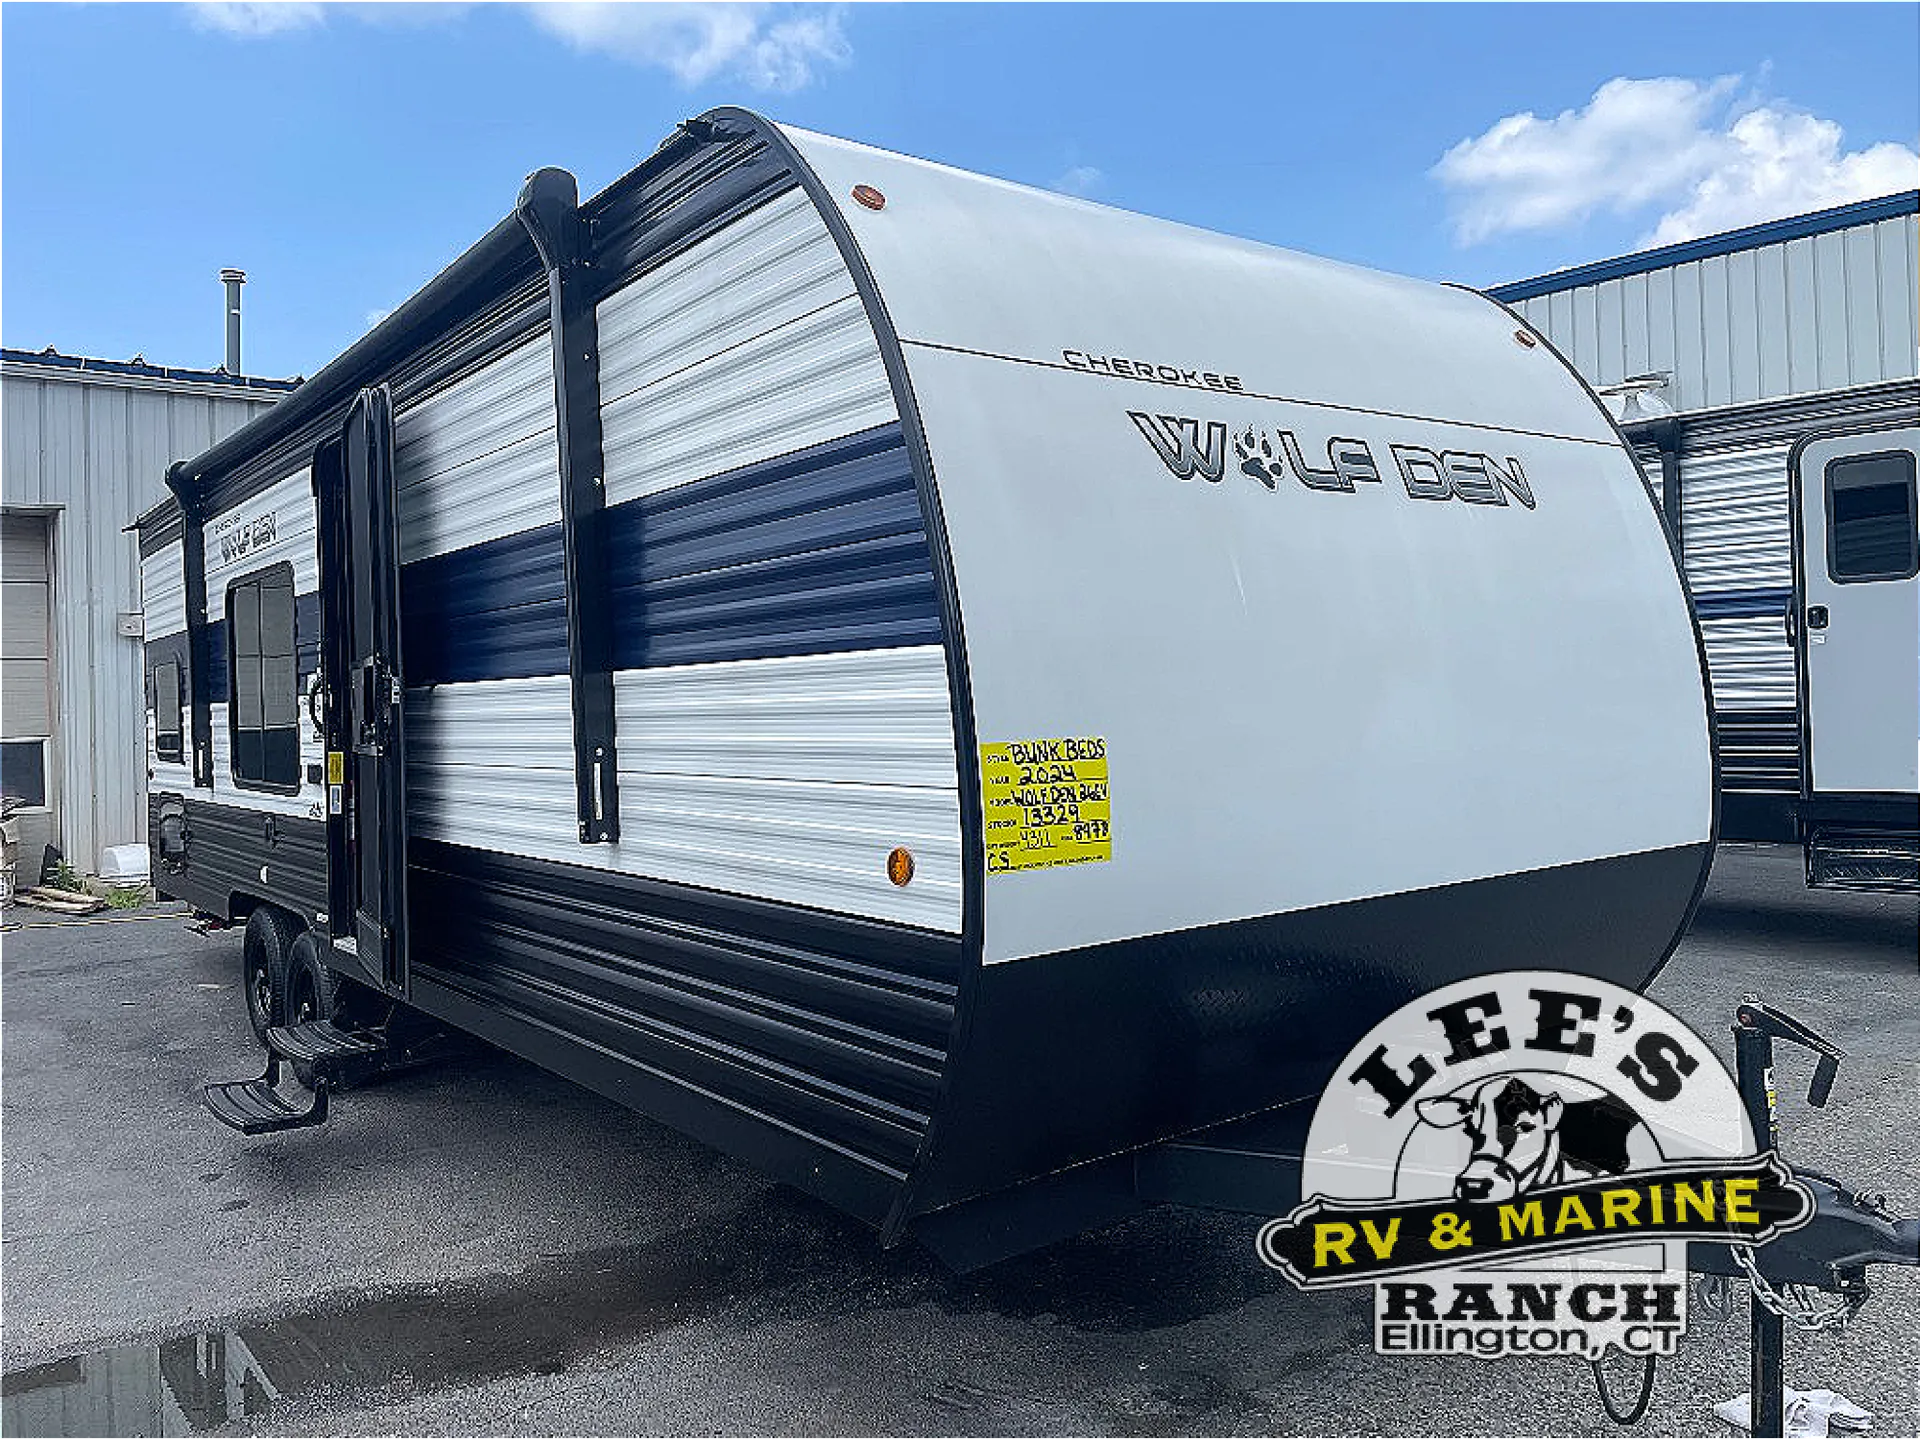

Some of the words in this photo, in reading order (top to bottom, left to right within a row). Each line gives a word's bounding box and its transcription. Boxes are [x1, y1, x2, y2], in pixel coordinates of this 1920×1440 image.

[1062, 349, 1244, 391] CHEROKEE
[1389, 443, 1536, 510] DEN
[1006, 741, 1060, 766] BUNK
[1062, 738, 1105, 761] BEDS
[1017, 765, 1076, 786] 2024
[1023, 804, 1080, 827] 13329
